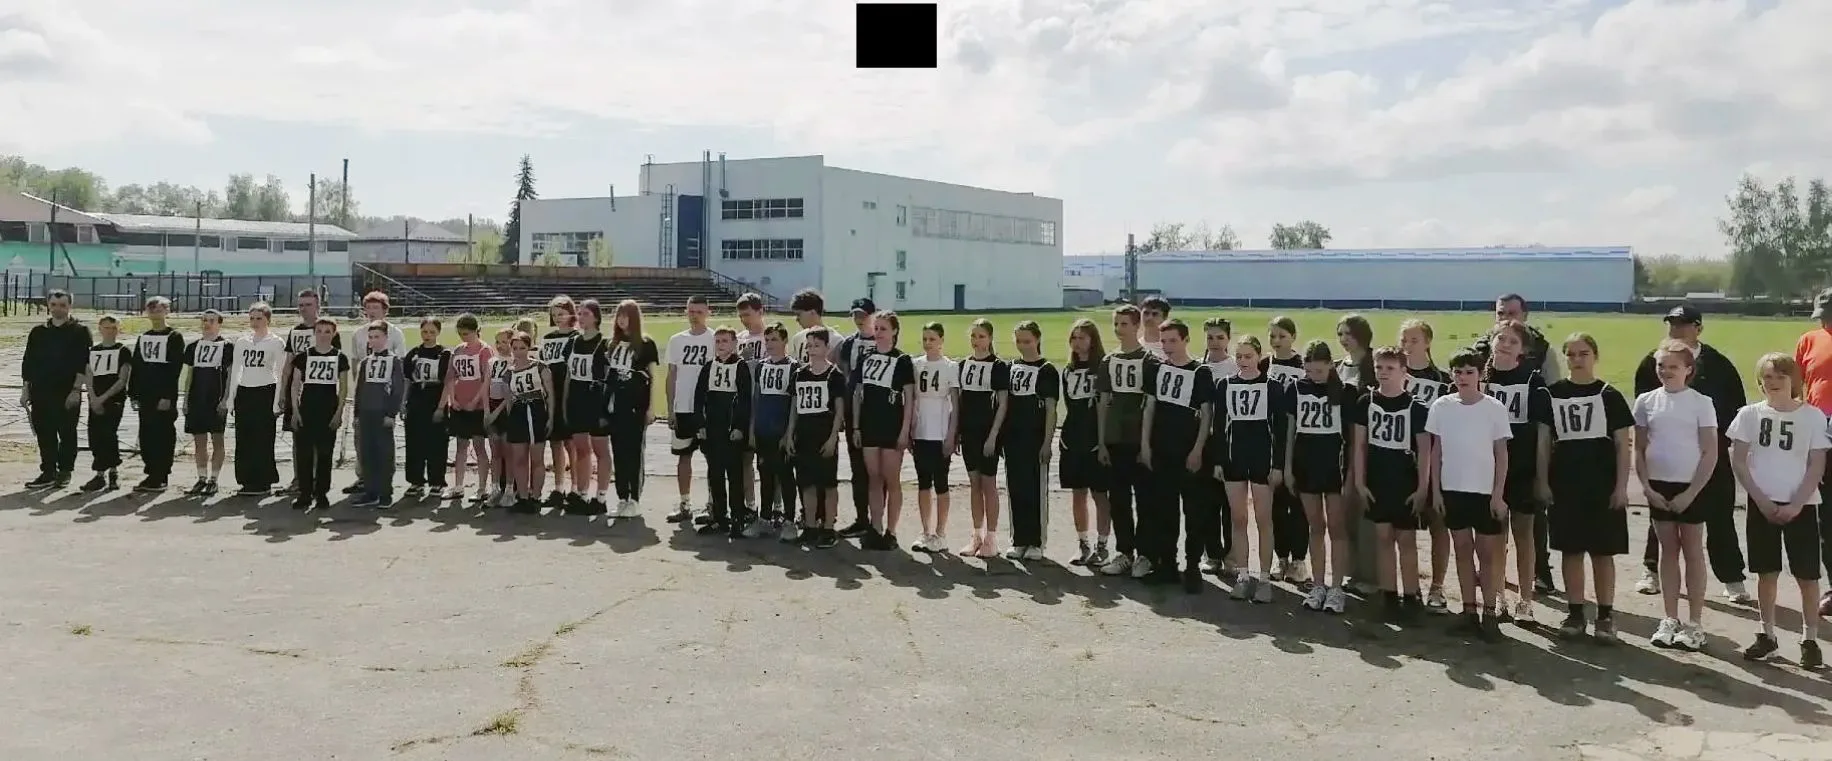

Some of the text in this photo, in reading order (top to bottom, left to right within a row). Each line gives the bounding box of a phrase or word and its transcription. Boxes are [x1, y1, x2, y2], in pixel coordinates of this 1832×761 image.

[143, 341, 161, 359] 134
[197, 345, 219, 363] 127
[293, 335, 312, 352] 125
[94, 354, 112, 372] 71
[243, 349, 265, 368] 222
[682, 345, 708, 365] 223
[309, 361, 336, 380] 225
[368, 359, 387, 379] 50
[571, 357, 587, 377] 90
[714, 366, 731, 388] 54
[863, 357, 891, 381] 227
[965, 364, 985, 385] 61
[1115, 363, 1136, 387] 86
[515, 373, 535, 393] 59
[763, 368, 784, 390] 168
[919, 370, 940, 393] 64
[1073, 372, 1093, 395] 75
[1160, 371, 1185, 399] 88
[798, 386, 822, 409] 233
[1231, 389, 1261, 416] 137
[1300, 401, 1333, 428] 228
[1559, 402, 1594, 433] 167
[1371, 410, 1405, 442] 230
[1758, 417, 1794, 450] 85
